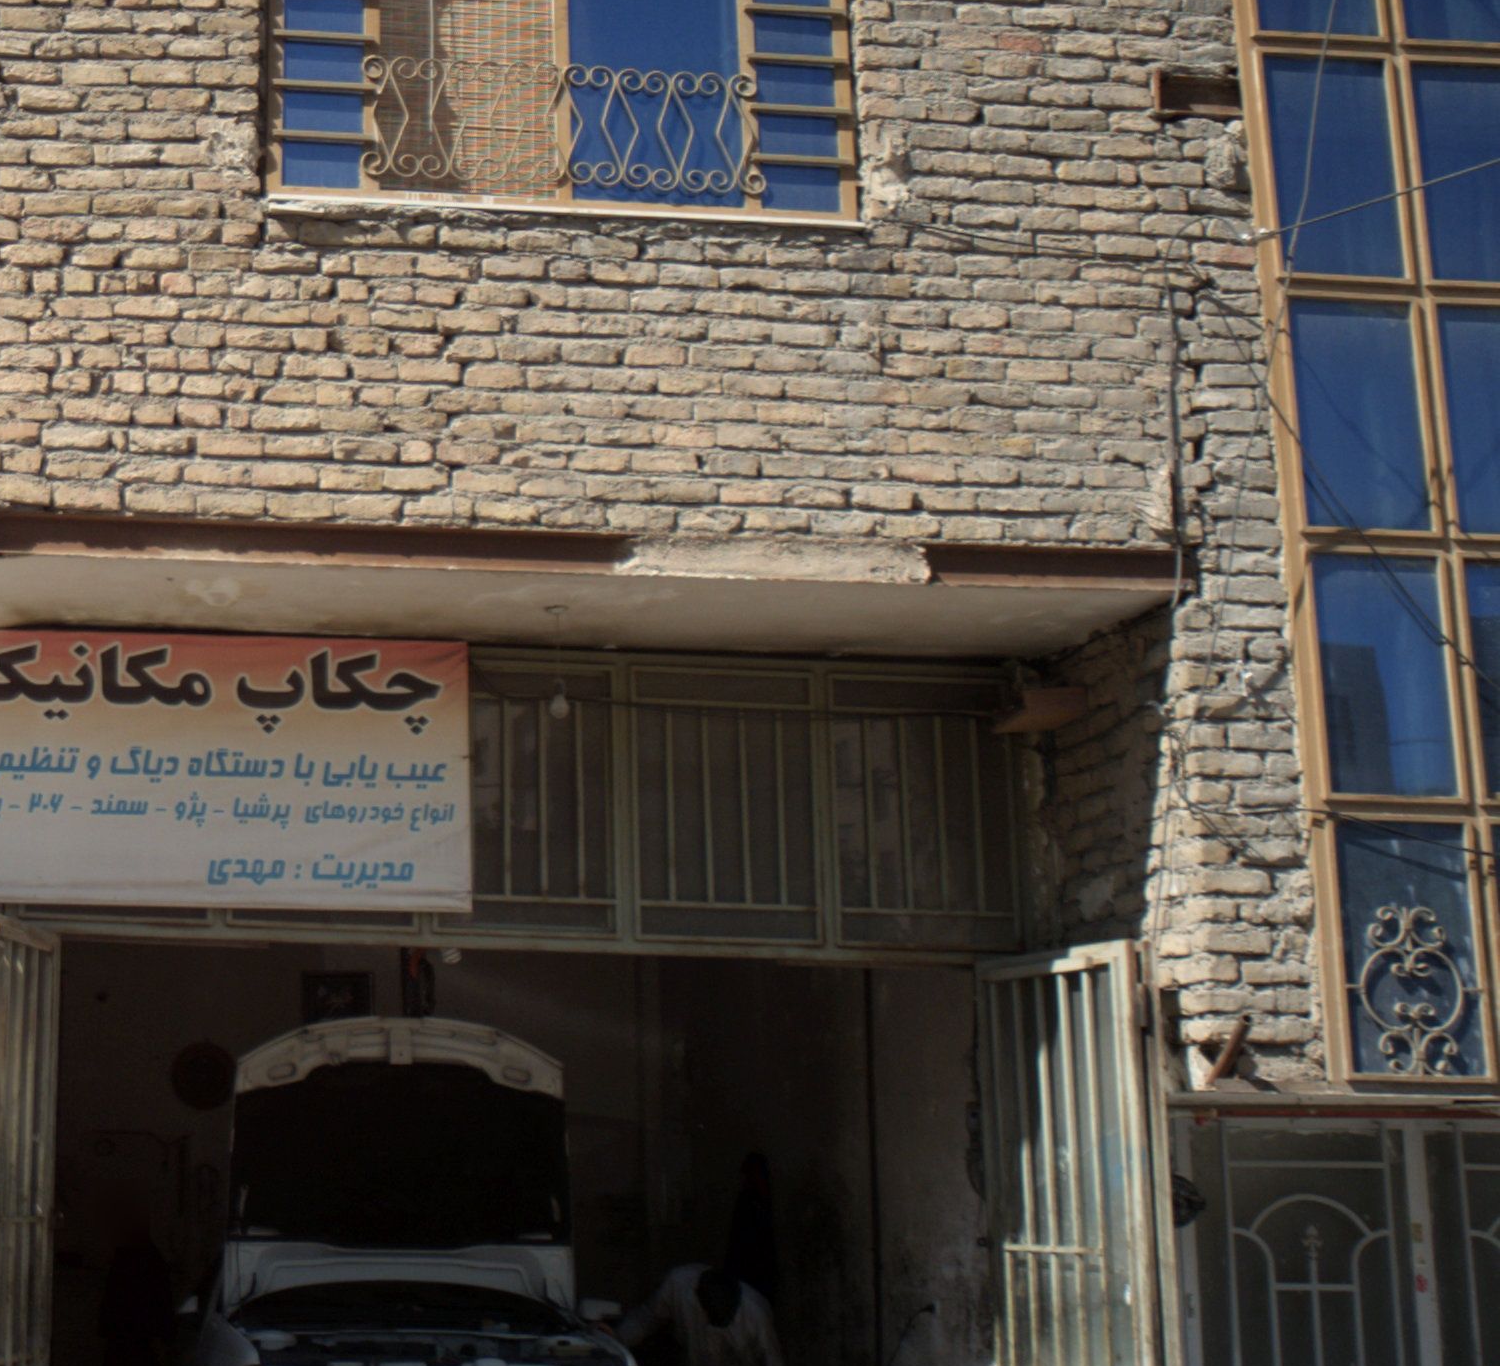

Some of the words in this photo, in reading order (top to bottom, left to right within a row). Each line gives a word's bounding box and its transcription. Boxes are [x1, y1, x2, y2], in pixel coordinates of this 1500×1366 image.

[237, 648, 441, 734] چکاپ
[85, 751, 102, 779] و
[110, 745, 180, 783] دیاگ
[187, 747, 286, 778] دستگاه
[294, 752, 316, 786] با
[322, 754, 379, 788] یابی
[386, 762, 447, 789] عیب
[90, 794, 149, 816] سمند
[174, 791, 207, 827] پژو
[232, 792, 291, 829] پرشیا
[304, 800, 405, 824] خودروهای
[410, 802, 455, 831] انواع
[206, 857, 287, 886] مهدی
[311, 853, 416, 889] مدیریت
